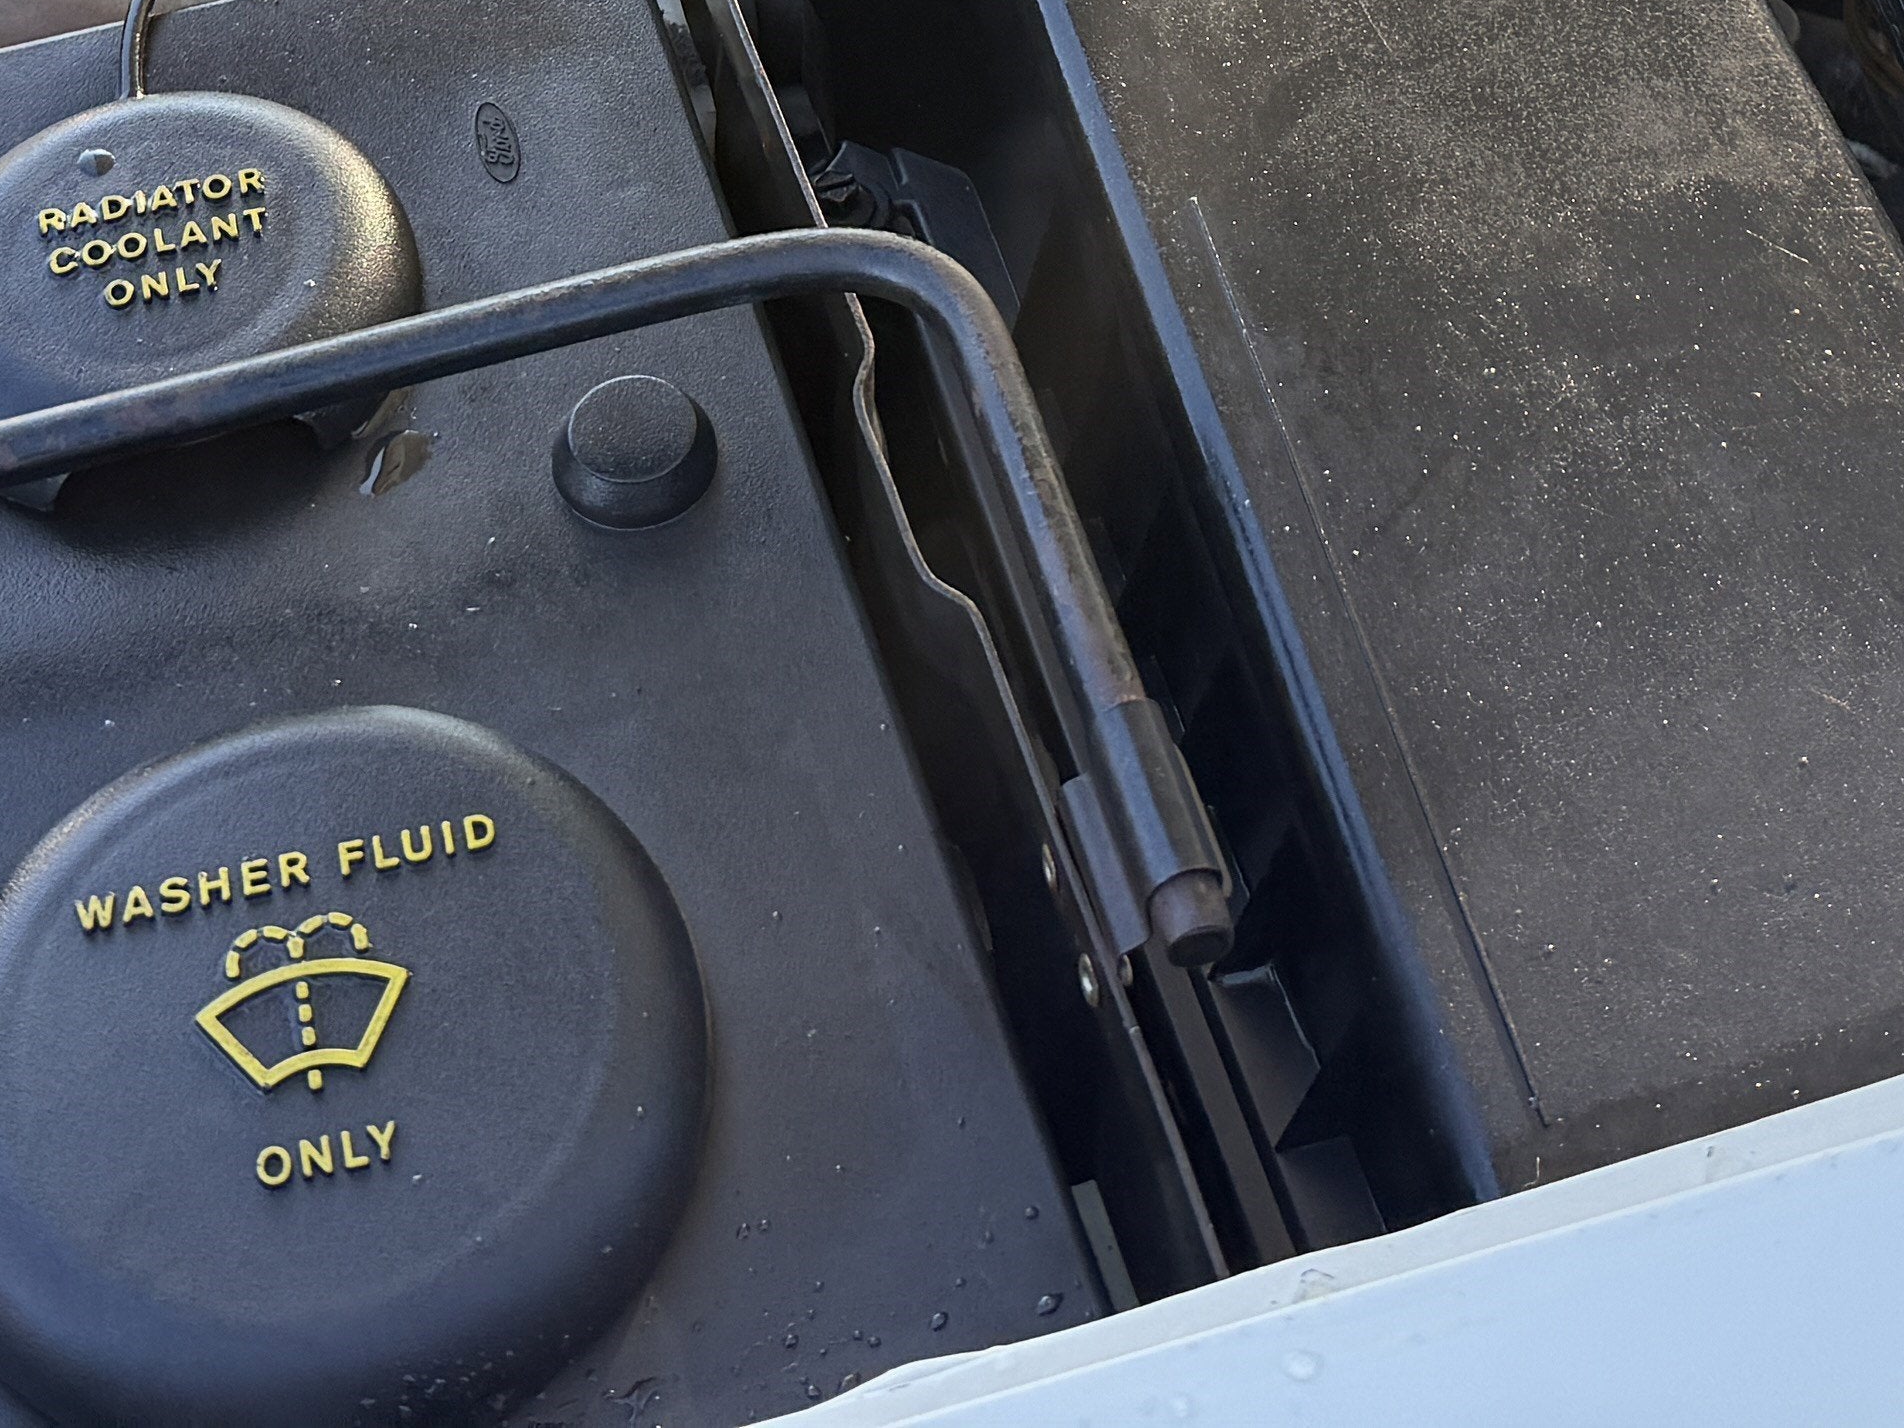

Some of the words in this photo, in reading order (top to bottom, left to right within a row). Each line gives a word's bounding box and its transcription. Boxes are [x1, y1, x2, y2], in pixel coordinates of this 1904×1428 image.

[37, 166, 270, 237] RADIATOR
[47, 205, 270, 276] COOLANT
[102, 258, 226, 310] ONLY
[74, 850, 311, 934] WASHER
[337, 812, 498, 878] FLUID
[254, 1120, 399, 1190] ONLY
